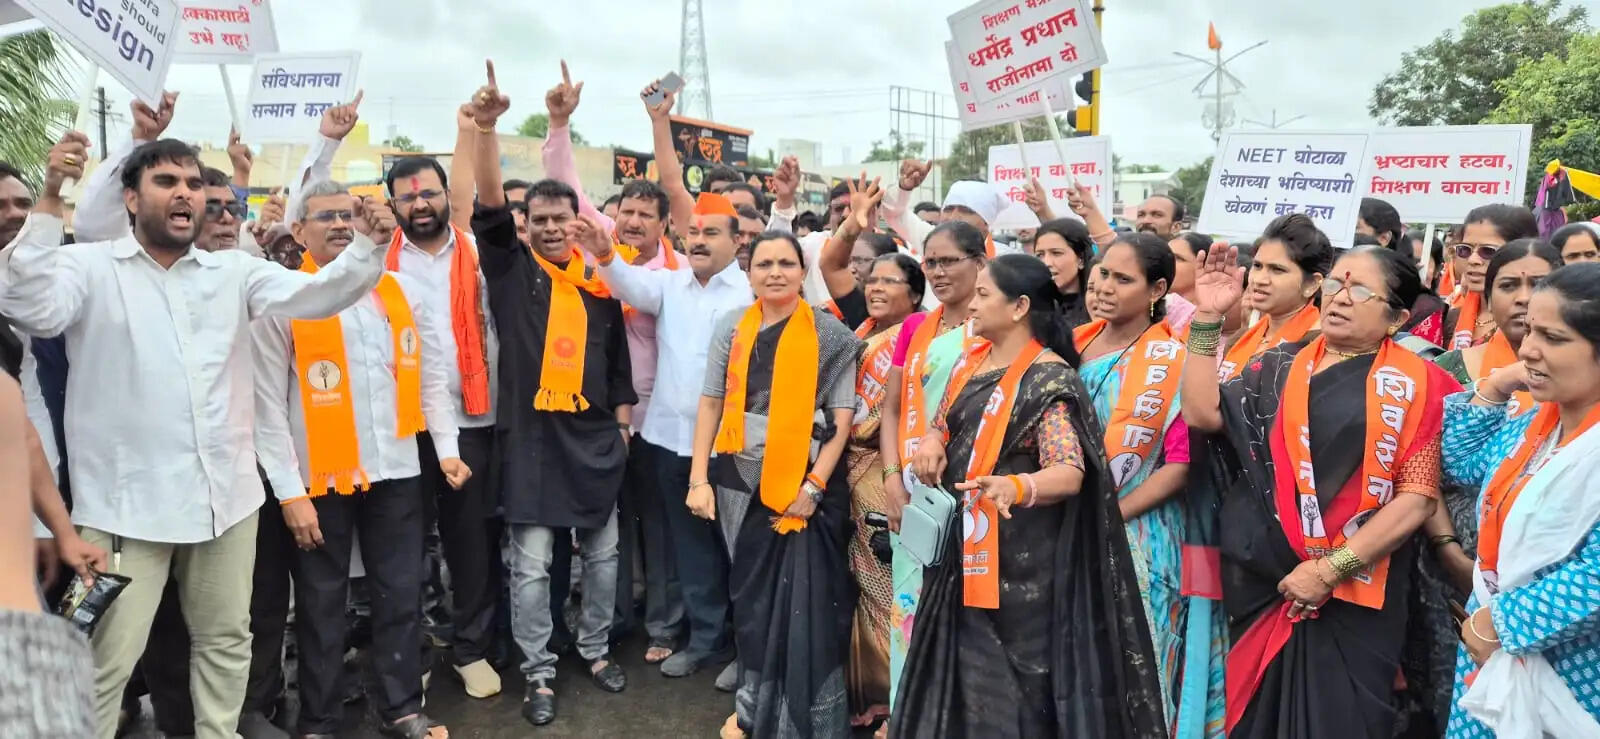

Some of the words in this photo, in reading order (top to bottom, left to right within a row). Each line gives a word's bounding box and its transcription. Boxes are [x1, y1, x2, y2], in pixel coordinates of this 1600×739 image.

[120, 0, 166, 45] should
[981, 4, 1021, 30] शिक्षण
[1020, 8, 1078, 47] प्रधान
[65, 0, 155, 72] esign
[188, 27, 215, 46] उभे
[262, 67, 343, 89] संविधानाचा
[986, 56, 1054, 93] राजीनामा
[1059, 42, 1078, 62] दो
[251, 102, 297, 118] सन्मान
[1237, 147, 1287, 163] NEET
[1294, 145, 1347, 166] घोटाळा
[1374, 155, 1450, 169] भ्रष्टाचार
[1459, 154, 1513, 171] हटवा,
[1220, 169, 1271, 189] देशाच्या
[1278, 171, 1355, 194] भविष्याशी
[1371, 176, 1431, 195] शिक्षण
[1225, 195, 1268, 215] खेळणं
[1304, 204, 1335, 220] करा
